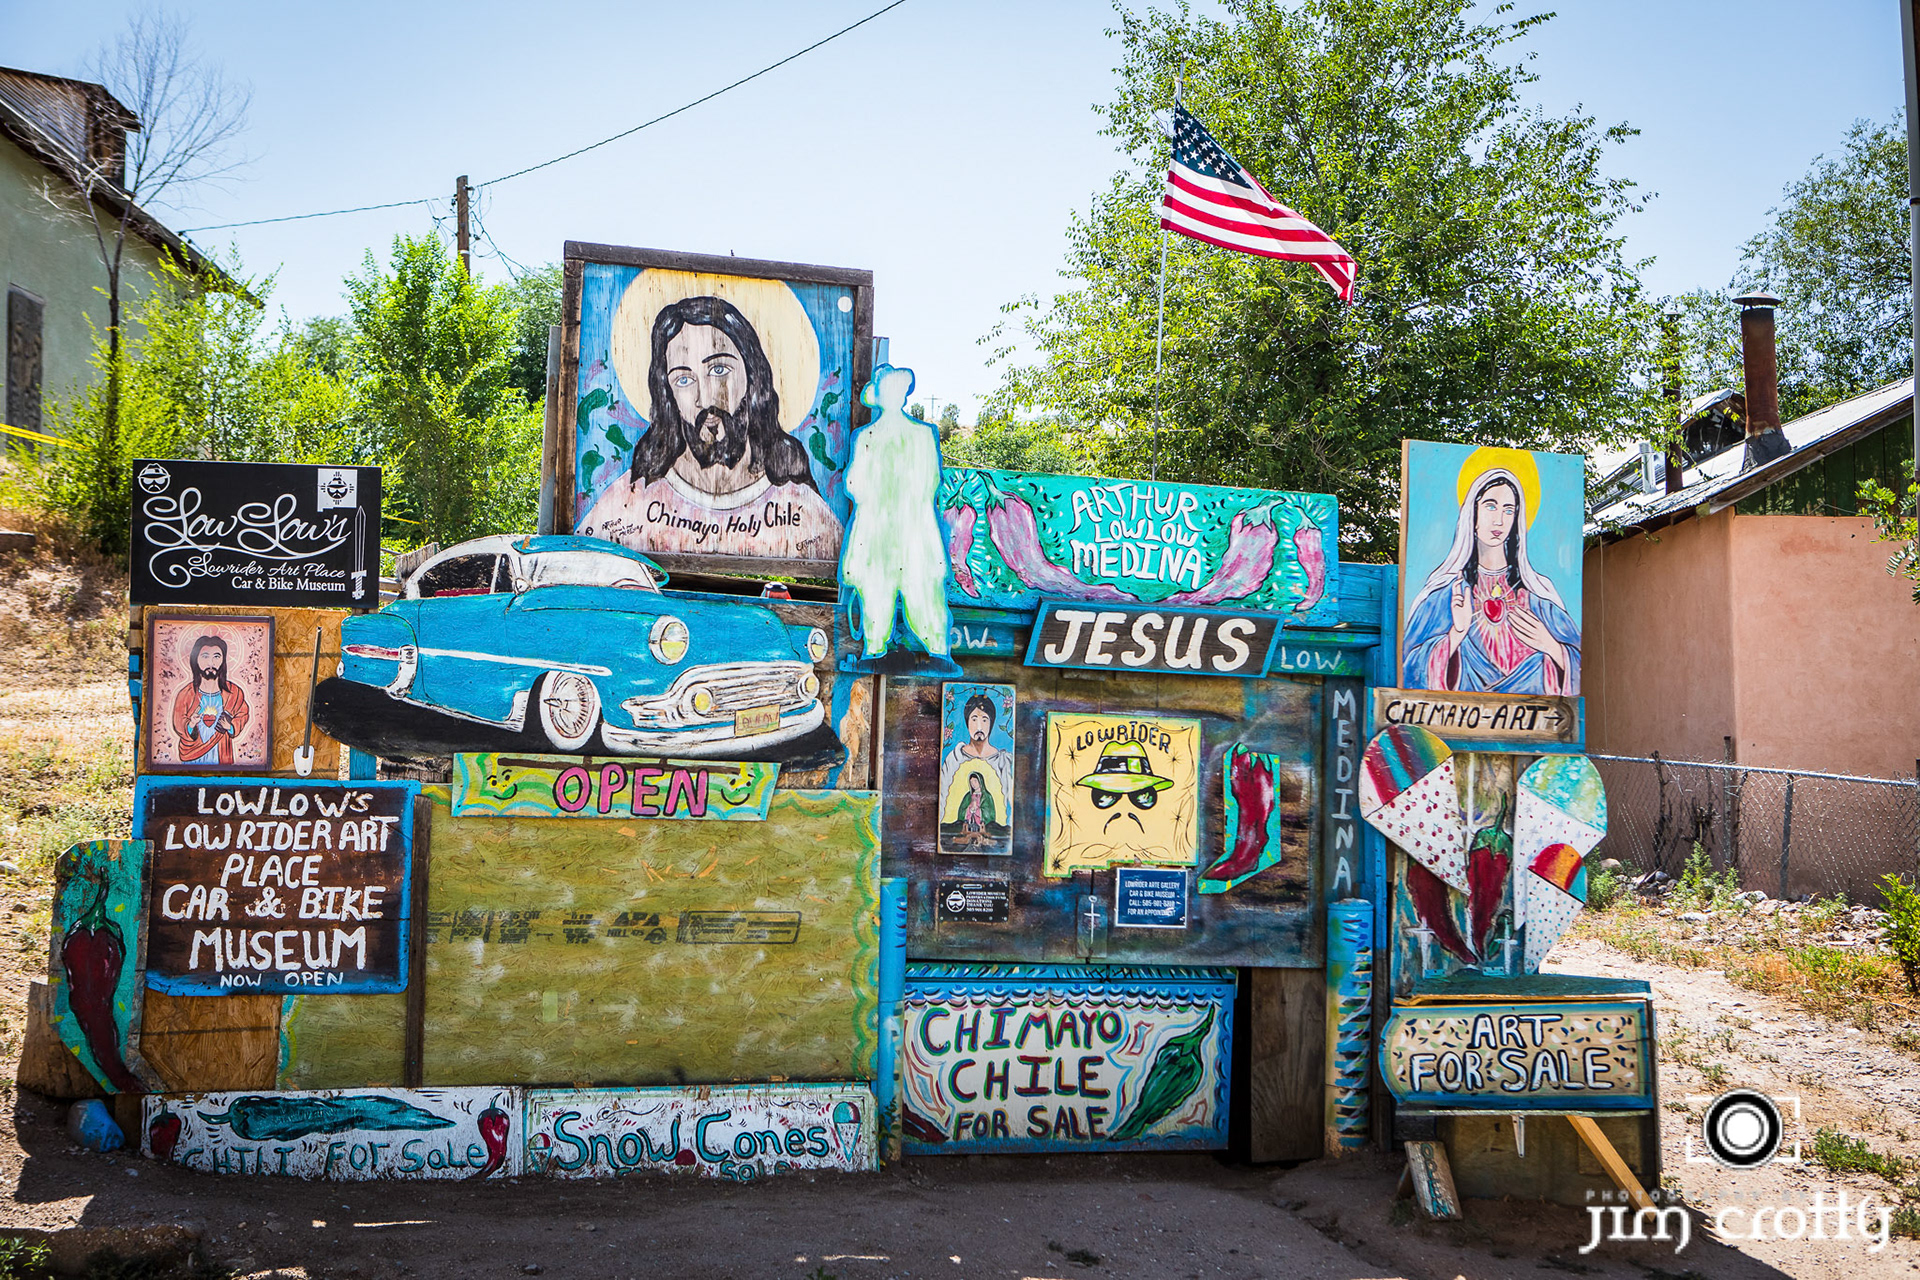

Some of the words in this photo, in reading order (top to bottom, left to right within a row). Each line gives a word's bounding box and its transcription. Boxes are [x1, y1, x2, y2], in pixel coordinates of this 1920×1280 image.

[646, 501, 719, 543] Chimayo
[726, 515, 762, 538] Holy
[1068, 482, 1203, 534] ARTHUR
[187, 552, 264, 578] Lowrider
[267, 563, 300, 577] Art
[302, 563, 346, 579] Place
[231, 576, 254, 590] Car
[255, 577, 266, 590] &
[268, 577, 294, 591] Bike
[295, 578, 346, 592] Museum
[1070, 540, 1203, 589] MEDINA
[1043, 608, 1258, 672] JESUS
[1281, 646, 1342, 671] LOW
[1076, 720, 1172, 754] LOWRIDER
[552, 761, 711, 819] OPEN
[1331, 688, 1357, 892] MEDINA
[338, 816, 399, 852] ART
[220, 854, 323, 889] PLACE
[162, 884, 231, 921] CAR
[245, 886, 286, 919] &
[299, 885, 386, 922] BIKE
[188, 926, 367, 972] MUSEUM
[220, 973, 263, 988] NOW
[284, 971, 344, 988] OPEN
[920, 1006, 1124, 1055] CHIMAYO
[1466, 1014, 1563, 1049] ART
[948, 1055, 1110, 1102] CHILE
[1410, 1051, 1485, 1092] FOR
[1499, 1047, 1615, 1093] SALE
[554, 1111, 682, 1171] Snow
[696, 1111, 830, 1163] Cones
[954, 1107, 1011, 1141] FOR
[1027, 1105, 1110, 1141] SALE
